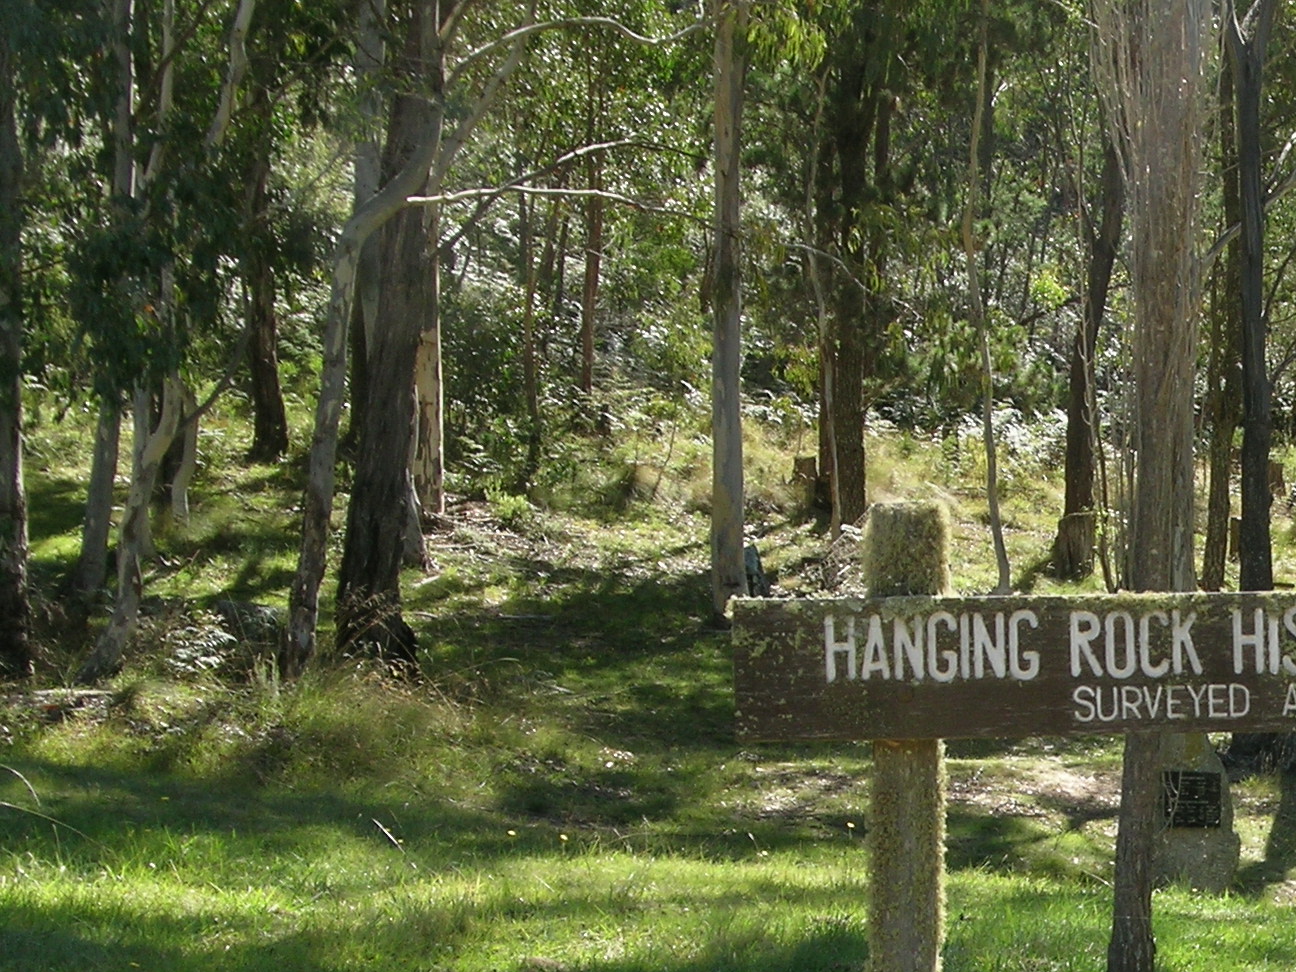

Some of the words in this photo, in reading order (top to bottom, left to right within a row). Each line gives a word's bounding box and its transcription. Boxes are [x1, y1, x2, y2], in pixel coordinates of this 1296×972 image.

[823, 609, 1041, 683] HANGING
[1069, 608, 1204, 679] ROCK
[1072, 683, 1251, 723] SURVEYED
